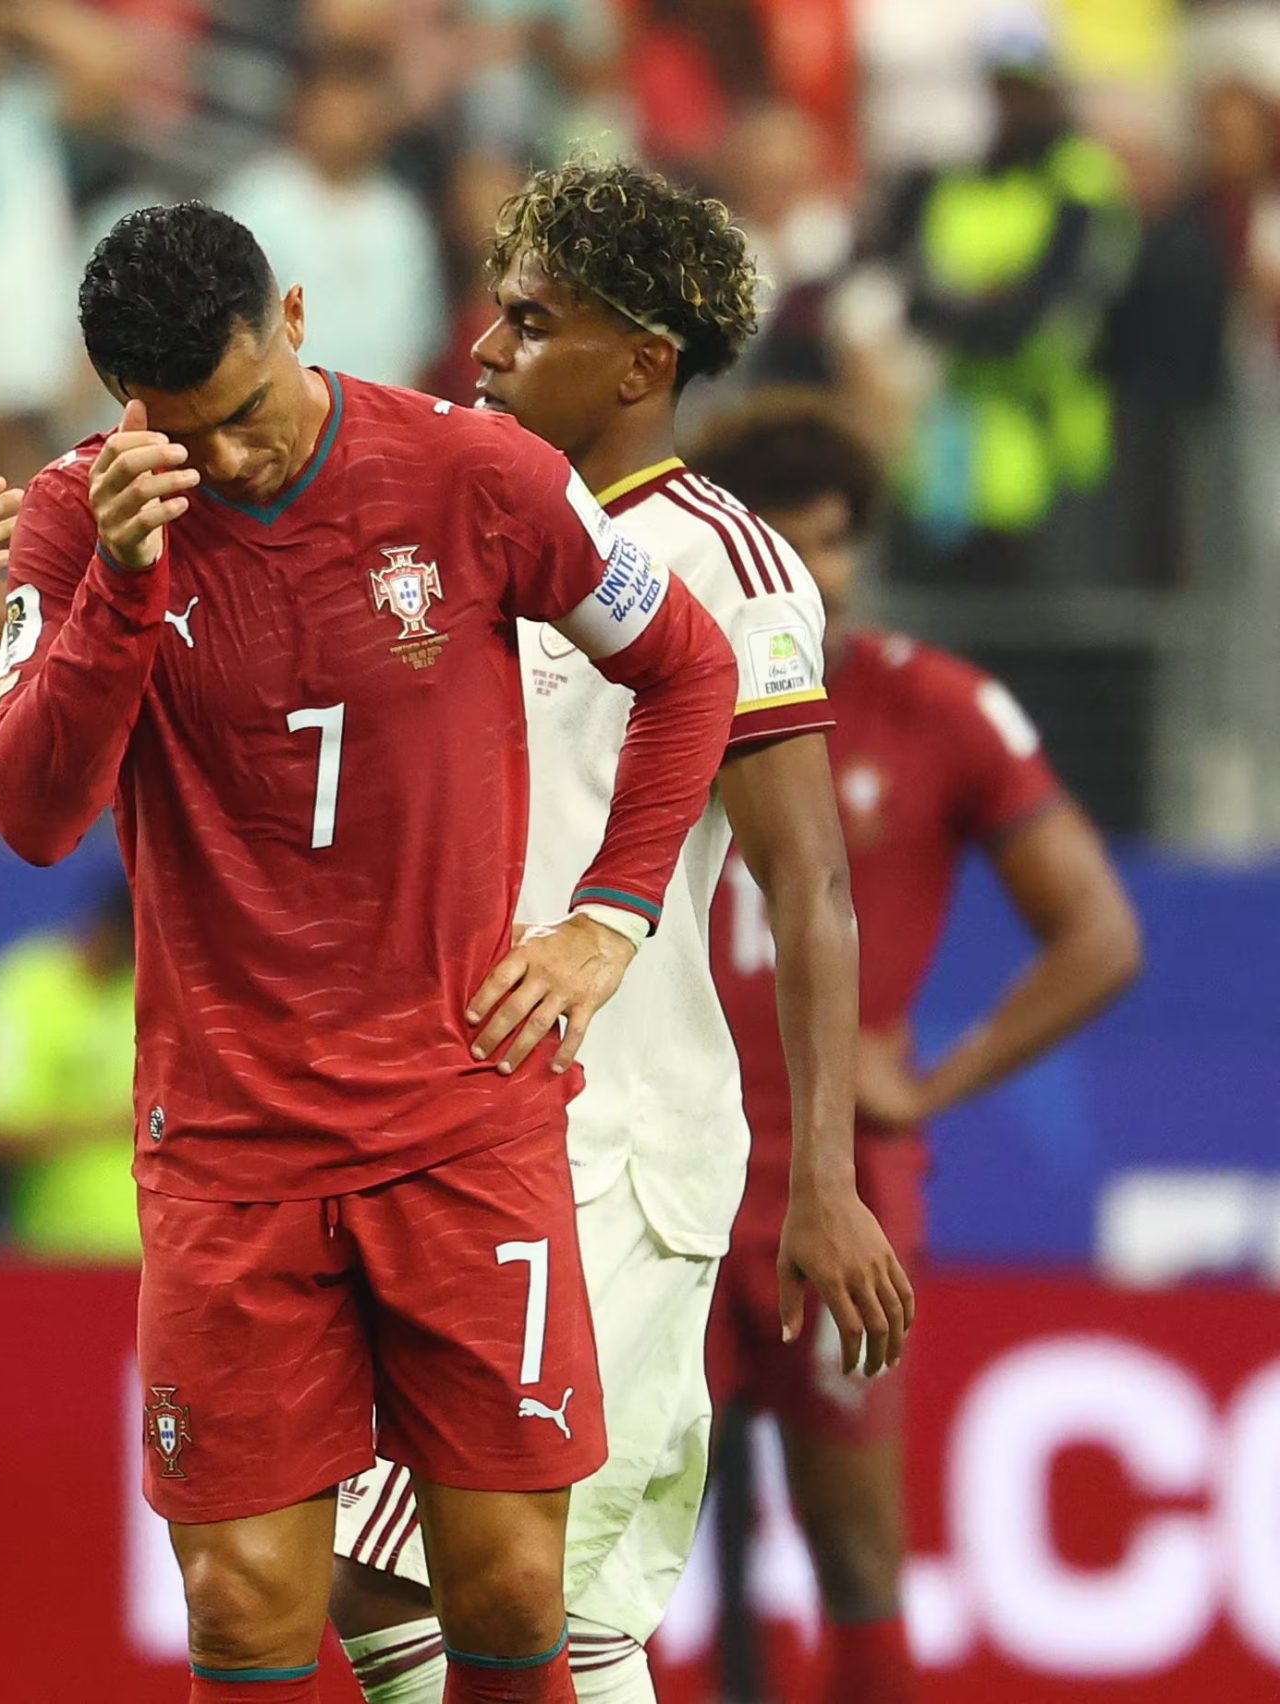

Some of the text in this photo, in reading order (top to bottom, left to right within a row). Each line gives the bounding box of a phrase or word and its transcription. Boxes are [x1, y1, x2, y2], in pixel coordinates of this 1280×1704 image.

[595, 537, 637, 606] UNITES
[609, 595, 636, 622] the
[286, 702, 345, 849] 7
[495, 1237, 549, 1385] 7
